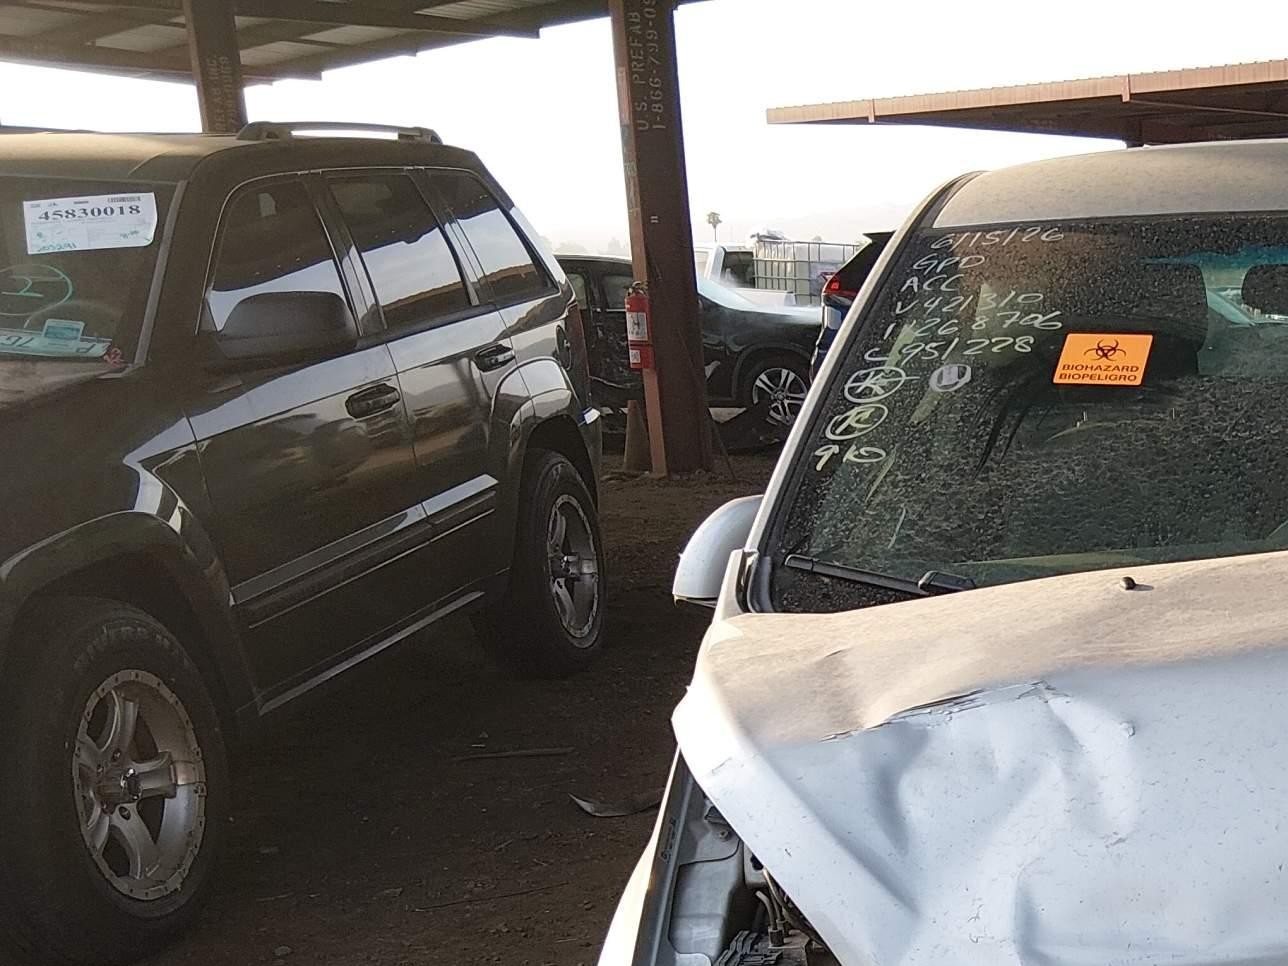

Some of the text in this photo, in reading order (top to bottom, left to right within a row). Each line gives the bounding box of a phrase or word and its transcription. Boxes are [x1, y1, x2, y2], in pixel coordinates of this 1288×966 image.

[627, 11, 646, 84] PREFAB
[38, 205, 141, 221] 45830018
[913, 253, 985, 275] GPD
[901, 273, 965, 292] ACC
[1062, 364, 1140, 373] BIOHAZARD
[1059, 373, 1137, 382] BIOPELIGRO
